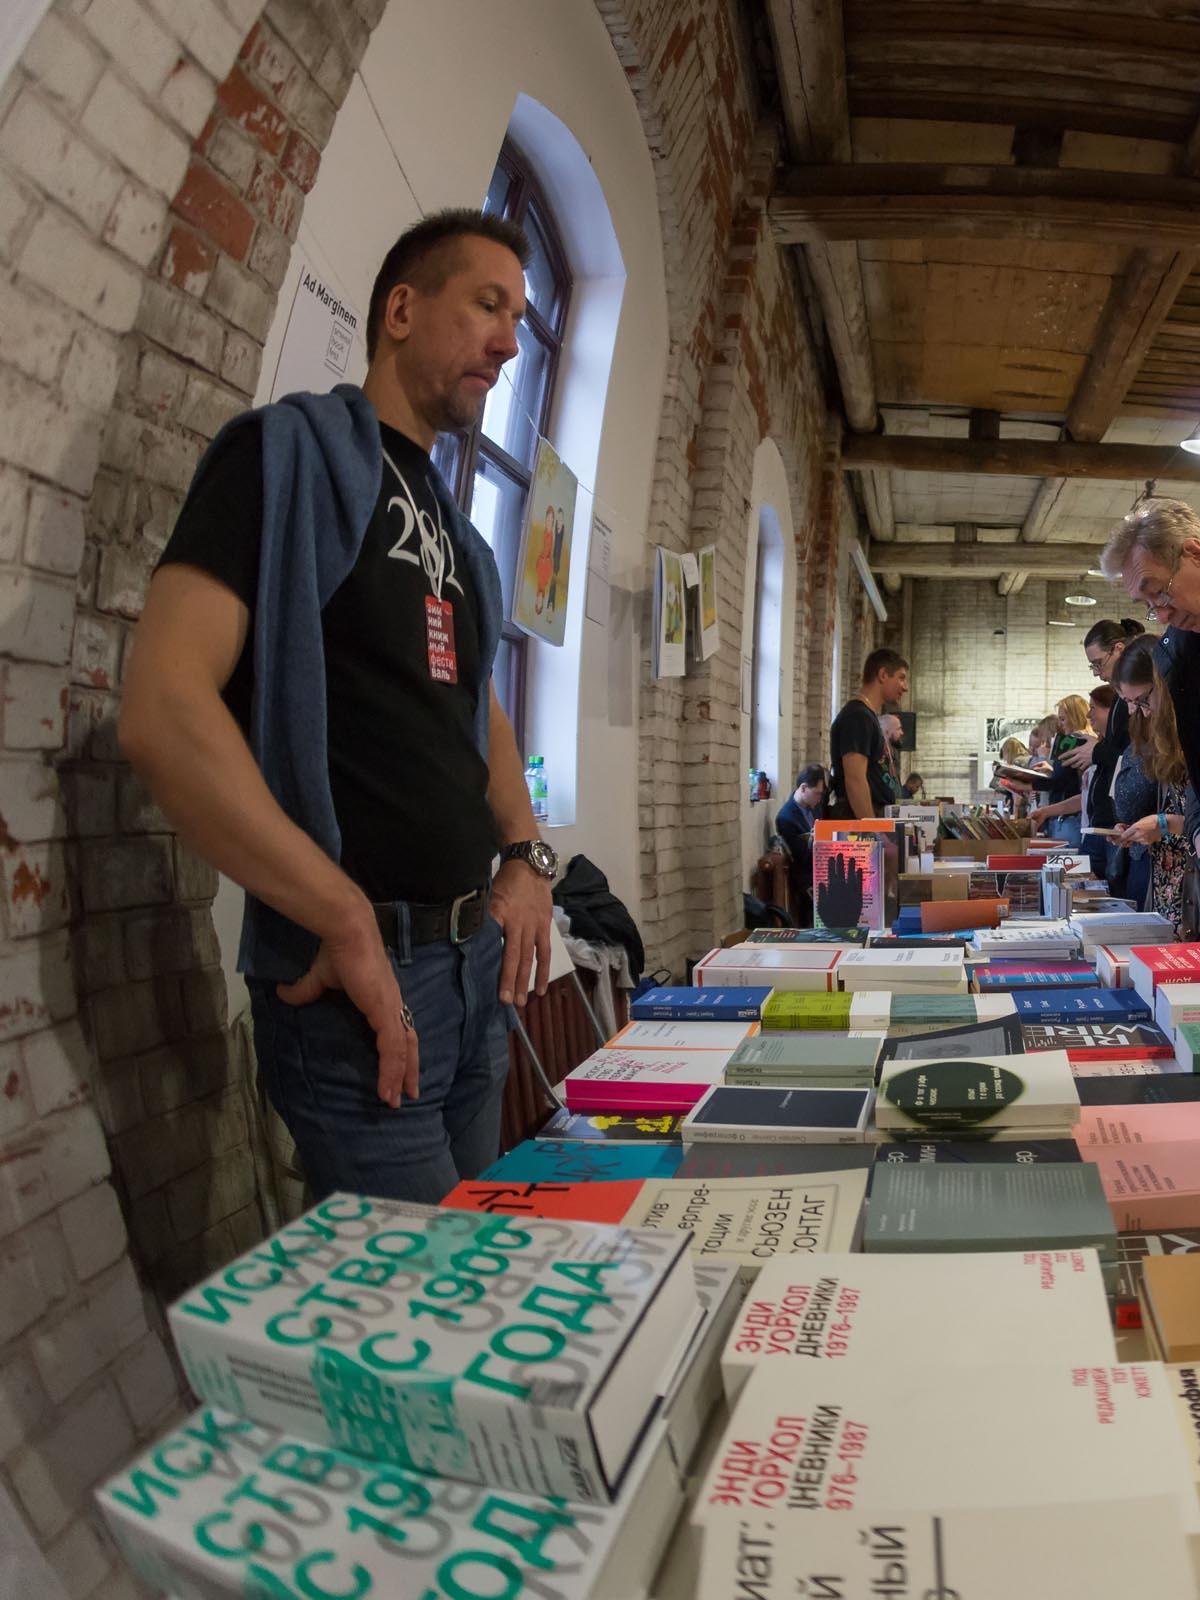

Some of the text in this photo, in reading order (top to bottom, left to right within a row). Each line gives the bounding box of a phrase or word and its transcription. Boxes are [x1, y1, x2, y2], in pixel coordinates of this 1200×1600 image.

[303, 273, 358, 329] Ad Marginem
[428, 630, 449, 643] книж
[702, 1213, 735, 1255] тации
[752, 1187, 794, 1259] СЬЮЗЕН
[180, 1194, 375, 1325] ИСКУС
[264, 1228, 428, 1346] СТВО
[359, 1331, 432, 1373] С
[461, 1259, 620, 1400] ГОДА
[735, 1300, 776, 1353] ЭНДИ
[765, 1285, 812, 1354] УОРХОЛ
[795, 1277, 840, 1358] ДНЕВНИКИ
[709, 1440, 761, 1506] ЭНДИ
[418, 1496, 574, 1600] ОД
